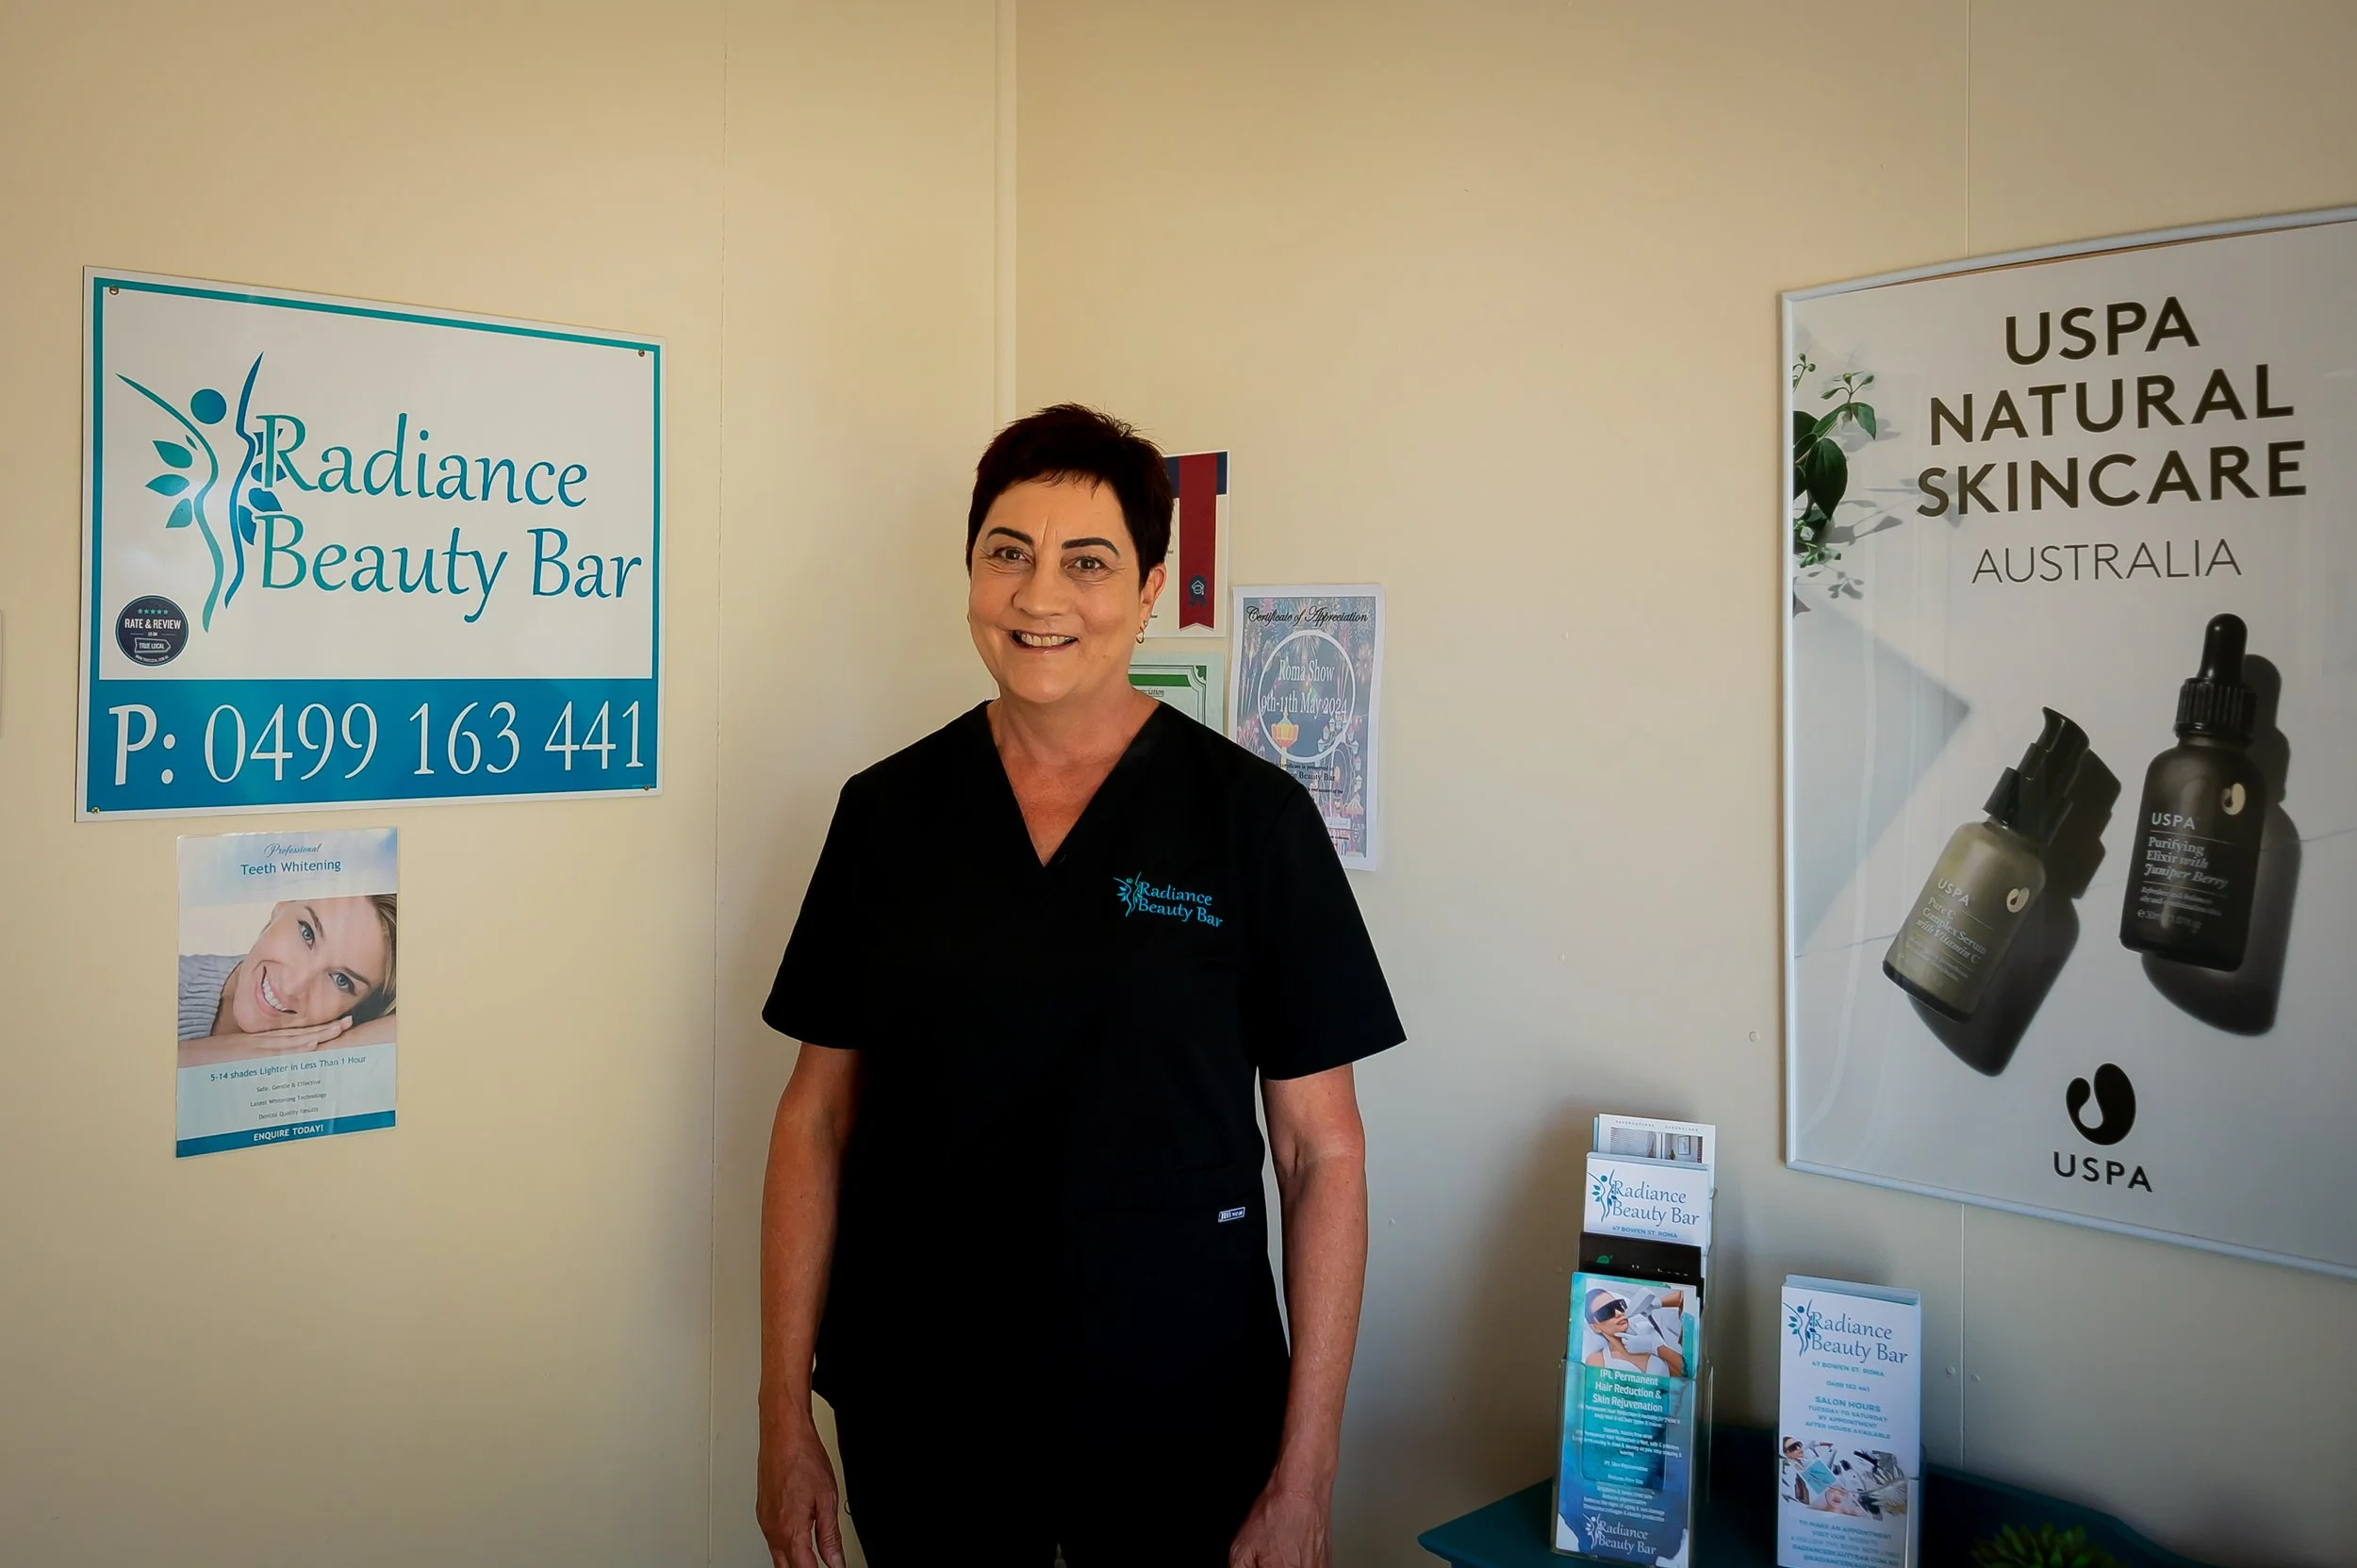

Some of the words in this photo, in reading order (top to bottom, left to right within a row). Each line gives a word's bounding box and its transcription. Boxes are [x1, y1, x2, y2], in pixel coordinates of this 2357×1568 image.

[2005, 296, 2200, 366] USPA
[1930, 364, 2294, 446] NATURAL
[255, 413, 587, 507] Radiance
[1916, 440, 2306, 518] SKINCARE
[255, 514, 507, 623] Beauty
[527, 528, 642, 598] Bar
[1971, 538, 2242, 584] AUSTRALIA
[124, 618, 143, 628] RATE
[145, 619, 151, 629] &
[153, 619, 181, 630] REVIEW
[1246, 605, 1292, 626] Certificate
[1294, 609, 1307, 626] of
[1305, 605, 1368, 626] Appreciation
[1278, 660, 1305, 681] Roma
[1309, 659, 1335, 682] Show
[1261, 690, 1297, 716] 9th-11th
[1300, 692, 1320, 718] May
[1323, 698, 1346, 714] 2024
[108, 704, 176, 786] P:
[204, 702, 377, 783] 0499
[408, 701, 520, 776] 163
[544, 700, 644, 771] 441
[1299, 772, 1321, 783] Beauty
[2151, 813, 2195, 830] USPA
[264, 843, 321, 858] Professional
[2148, 836, 2205, 857] Purifying
[240, 864, 276, 875] Teeth
[281, 860, 341, 872] Whitening
[2146, 850, 2178, 864] Elixir
[2180, 856, 2209, 869] with
[2144, 864, 2191, 880] Juniper
[2193, 871, 2229, 889] Berry
[1139, 881, 1212, 905] Radiance
[1938, 877, 1970, 907] USPA
[1139, 898, 1194, 922] Beauty
[1196, 907, 1223, 928] Bar
[1928, 897, 1946, 915] Pure
[1947, 909, 1955, 920] C
[1916, 919, 1935, 933] with
[1934, 928, 1970, 958] Vitamin
[1970, 954, 1980, 964] C
[1923, 907, 1960, 938] Complex
[1958, 931, 1986, 954] Serum
[211, 1072, 228, 1081] 5-14
[231, 1068, 256, 1079] shades
[260, 1065, 288, 1077] Lighter
[301, 1061, 317, 1070] Less
[320, 1058, 338, 1067] Than
[269, 1096, 296, 1105] Whitening
[297, 1092, 326, 1101] Technology
[279, 1110, 298, 1118] Quality
[254, 1129, 289, 1141] ENQUIRE
[292, 1124, 324, 1135] TODAY!
[2053, 1151, 2153, 1193] USPA
[1612, 1180, 1686, 1203] Radiance
[1612, 1200, 1667, 1227] Beauty
[1671, 1207, 1700, 1226] Bar
[1622, 1227, 1646, 1235] BOWEN
[1811, 1311, 1893, 1340] Radiance
[1811, 1333, 1871, 1363] Beauty
[1876, 1343, 1908, 1363] Bar
[1600, 1369, 1612, 1379] IPL
[1614, 1371, 1659, 1386] Permanent
[1821, 1362, 1850, 1371] BOWEN
[1863, 1367, 1884, 1377] ROMA
[1595, 1380, 1612, 1392] Hair
[1614, 1384, 1654, 1398] Reduction
[1655, 1390, 1661, 1399] &
[1592, 1394, 1610, 1405] Skin
[1611, 1395, 1663, 1412] Rejuvenation
[1808, 1405, 1839, 1414] TUESDAY
[1852, 1411, 1887, 1422] SATURDAY
[1816, 1395, 1846, 1407] SALON
[1848, 1401, 1882, 1412] HOURS
[1828, 1424, 1852, 1433] HOURS
[1854, 1428, 1891, 1440] AVAILABLE
[1829, 1416, 1877, 1428] APPOINTMENT
[1599, 1520, 1648, 1540] Radiance
[1598, 1535, 1635, 1555] Beauty
[1637, 1541, 1656, 1555] Bar
